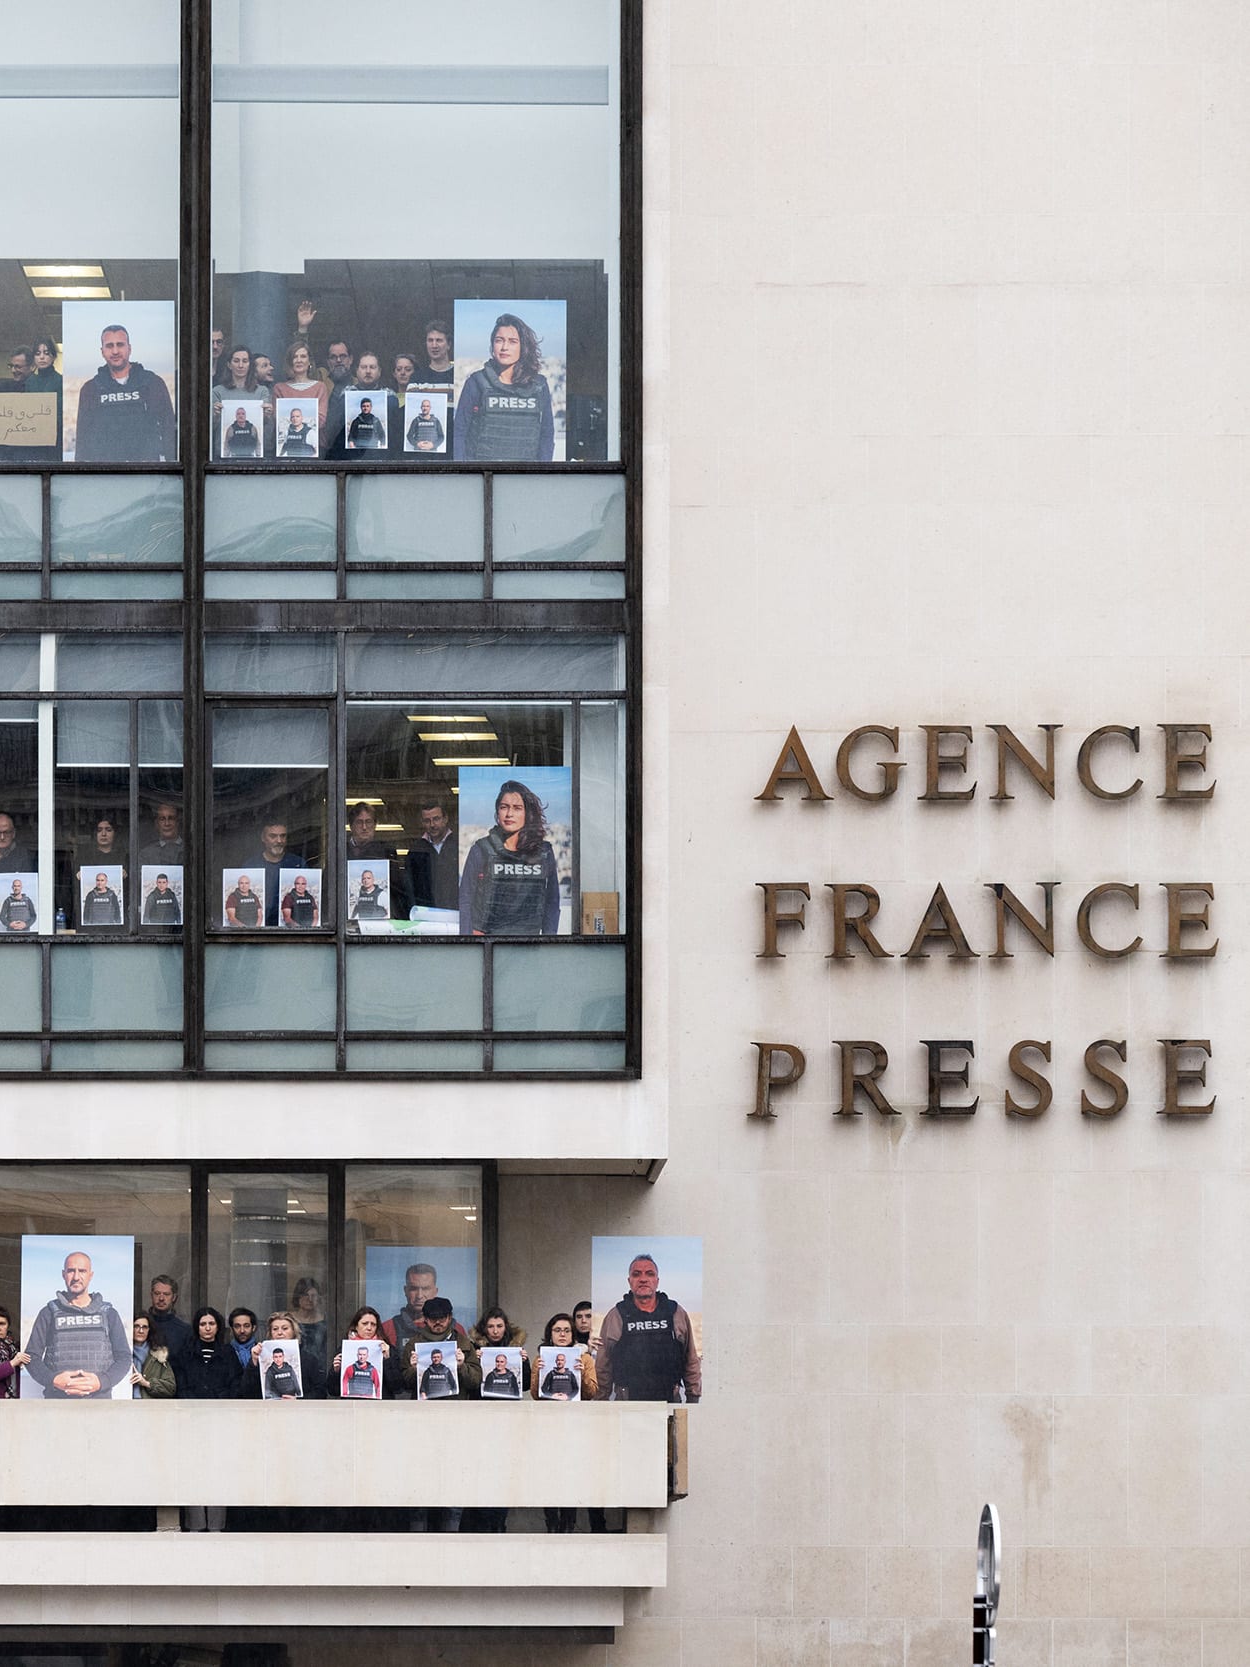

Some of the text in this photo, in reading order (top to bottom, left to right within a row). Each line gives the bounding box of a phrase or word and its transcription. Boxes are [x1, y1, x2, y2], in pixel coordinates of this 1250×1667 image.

[101, 391, 140, 403] PRESS
[488, 397, 536, 408] PRESS
[754, 723, 1217, 801] AGENCE
[494, 864, 541, 875] PRESS
[754, 881, 1220, 959] FRANCE
[746, 1039, 1218, 1119] PRESSE
[57, 1315, 101, 1326] PRESS
[628, 1320, 668, 1331] PRESS
